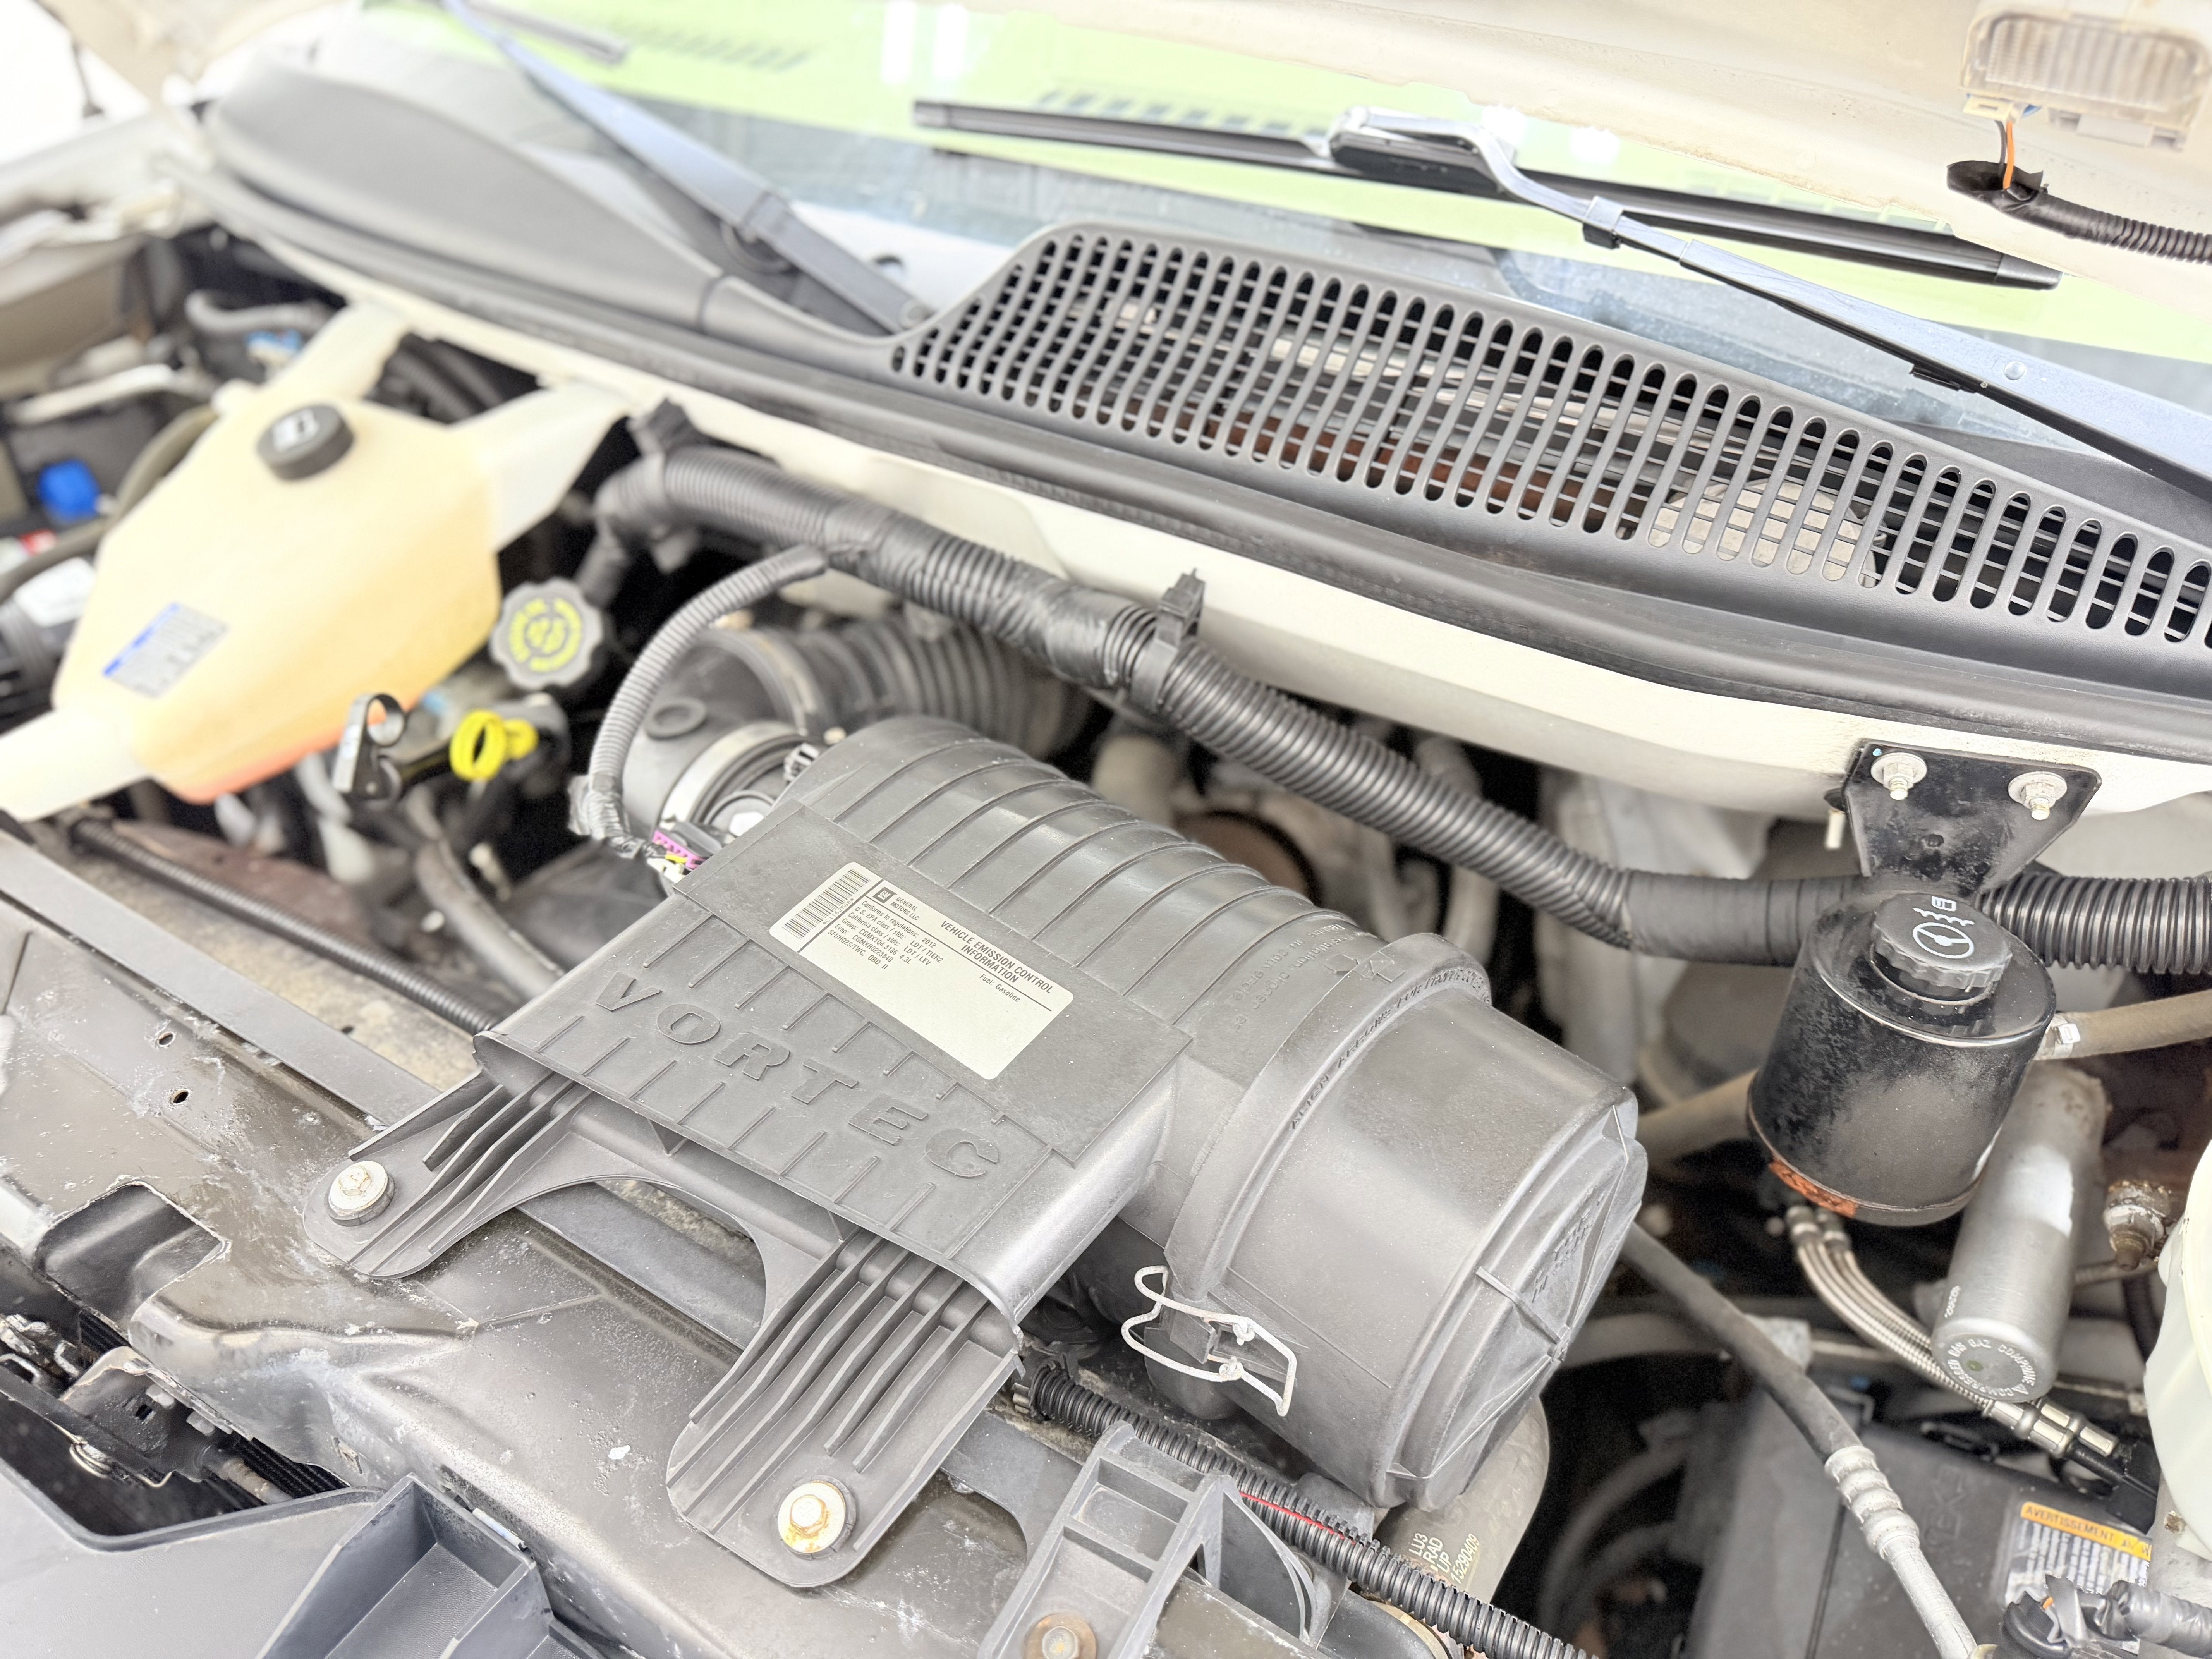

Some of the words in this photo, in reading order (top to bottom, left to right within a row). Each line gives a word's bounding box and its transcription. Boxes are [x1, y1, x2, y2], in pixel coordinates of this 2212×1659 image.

[880, 890, 891, 899] GM
[890, 902, 910, 915] MOTORS
[909, 912, 920, 921] LLC
[896, 897, 918, 912] GENERAL
[841, 918, 858, 930] Group:
[859, 929, 898, 955] CGMXT04.3186
[899, 954, 912, 965] 4.3L
[848, 912, 871, 929] California
[872, 927, 884, 937] class
[887, 936, 900, 947] stds:
[903, 946, 917, 956] LDT
[919, 956, 932, 965] LEV
[855, 906, 866, 916] U.S.
[866, 913, 877, 922] EPA
[877, 921, 890, 930] class
[893, 930, 907, 940] stds:
[910, 940, 923, 950] LDT
[927, 950, 944, 963] TIER2
[862, 901, 884, 917] Conforms
[890, 918, 919, 938] regulations:
[921, 937, 937, 948] 2012
[835, 924, 849, 934] Evap:
[852, 934, 894, 963] CGMXR0223840
[868, 955, 883, 966] OBD:
[940, 921, 975, 944] VEHICLE
[974, 941, 1015, 969] EMISSION
[1014, 967, 1053, 994] CONTROL
[961, 945, 1019, 983] INFORMATION
[979, 974, 994, 986] Fuel:
[995, 984, 1020, 1003] Gasoline
[595, 972, 1000, 1178] VORTEC
[2027, 1506, 2116, 1542] AVERTISSEMENT
[1408, 1532, 1428, 1556] LU3
[1422, 1537, 1444, 1565] RAD
[1436, 1551, 1452, 1573] UP
[1450, 1533, 1480, 1584] 15290409
